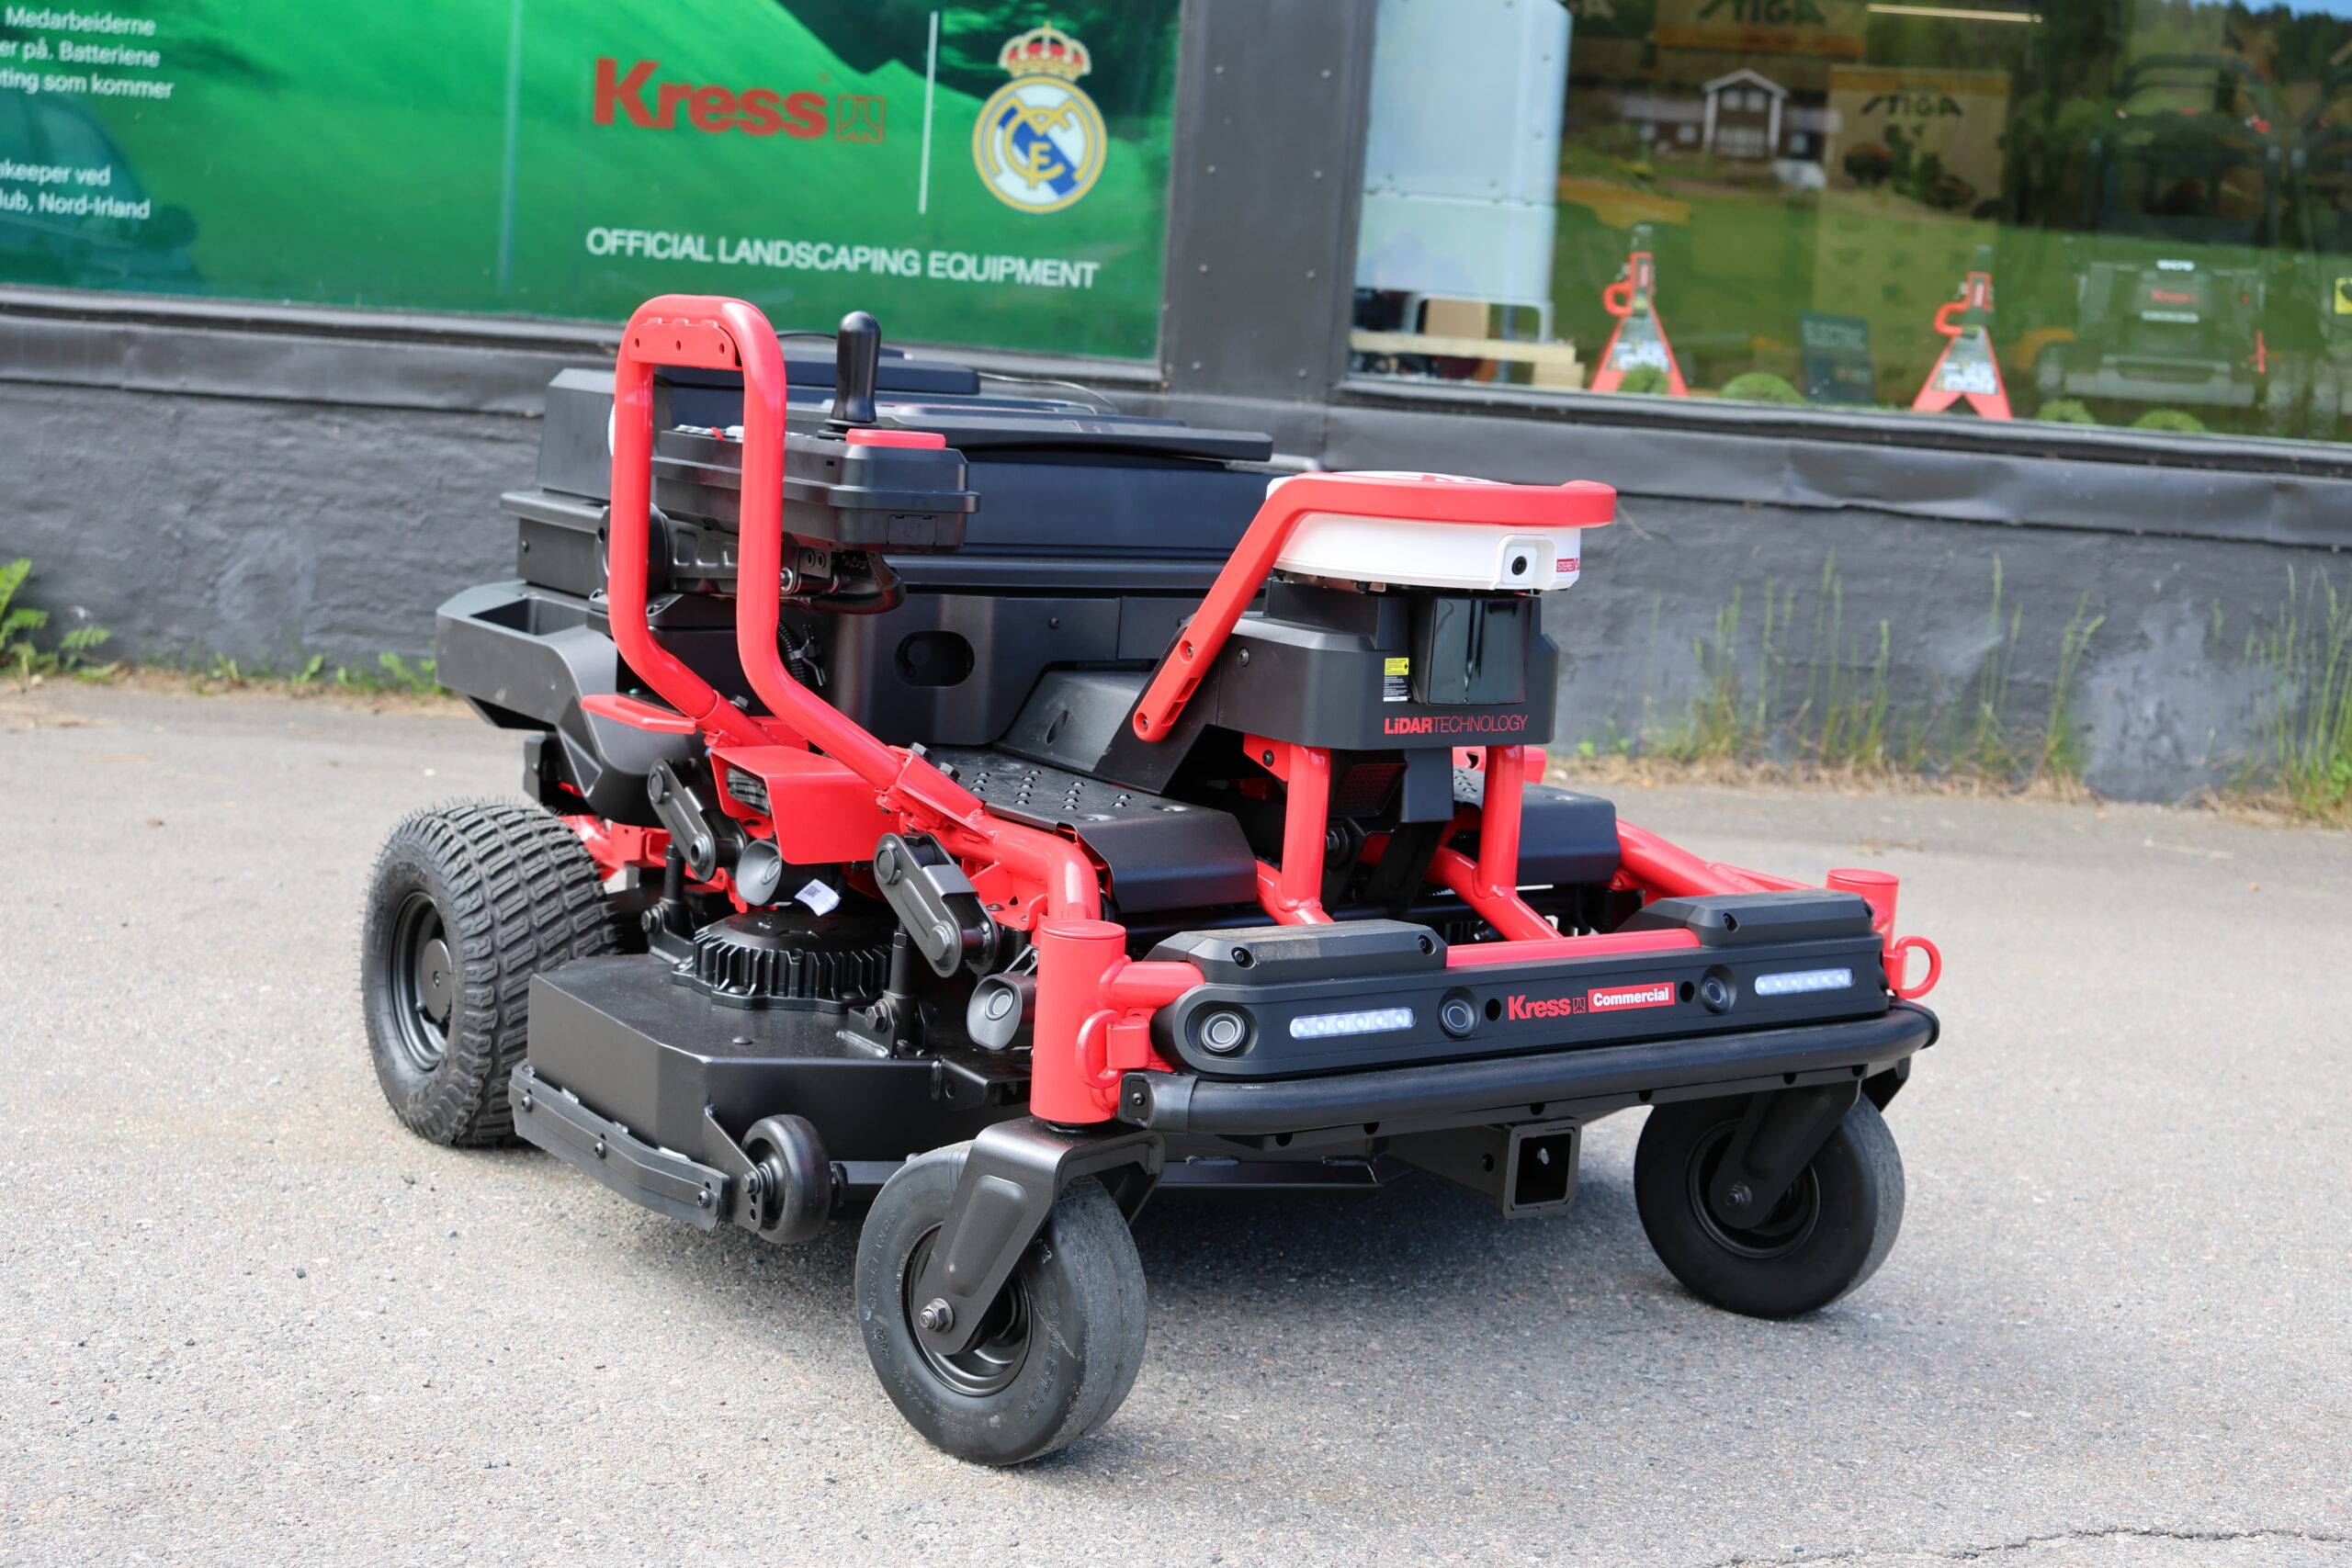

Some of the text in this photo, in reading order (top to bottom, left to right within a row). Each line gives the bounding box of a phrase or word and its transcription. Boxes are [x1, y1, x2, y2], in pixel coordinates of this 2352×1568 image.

[6, 6, 156, 37] Medarbeiderne
[59, 39, 161, 68] Batteriene
[43, 73, 87, 93] som
[92, 73, 175, 99] kommer
[594, 57, 828, 140] Kress
[1860, 95, 1964, 117] STIGA
[74, 164, 111, 186] ved
[39, 191, 151, 220] Nord-Irland
[586, 226, 1101, 289] OFFICIAL LANDSCAPING EQUIPMENT
[1508, 987, 1670, 1021] Kress Commercial
